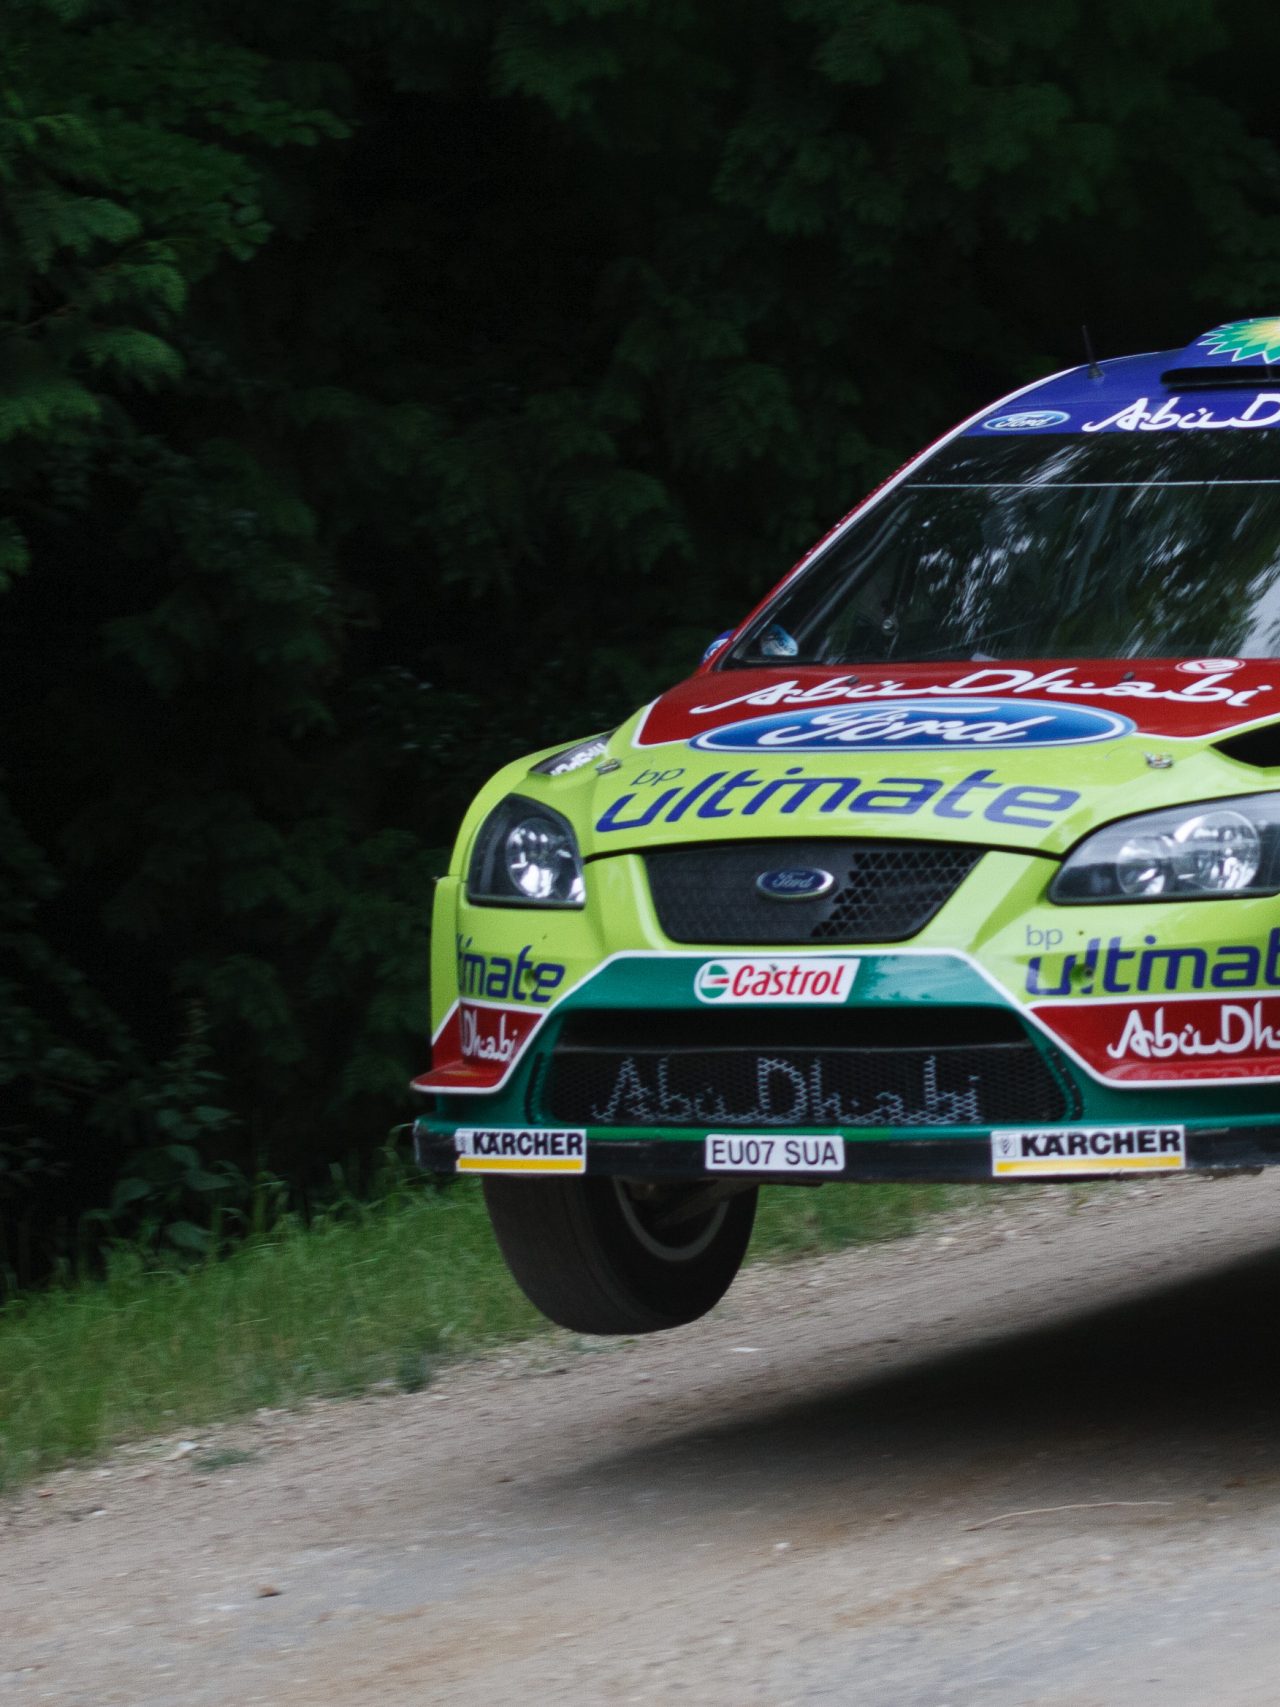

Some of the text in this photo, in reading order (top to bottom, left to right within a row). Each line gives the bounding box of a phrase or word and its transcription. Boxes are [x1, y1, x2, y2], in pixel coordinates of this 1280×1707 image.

[757, 703, 1060, 746] Ford
[630, 767, 686, 787] bp
[595, 766, 1082, 833] ultimate
[1025, 925, 1063, 948] bp
[731, 964, 847, 997] Castrol
[473, 1131, 583, 1156] KÄRCHER
[711, 1142, 839, 1166] EU07 SUA
[1021, 1130, 1181, 1157] KÄRCHER
